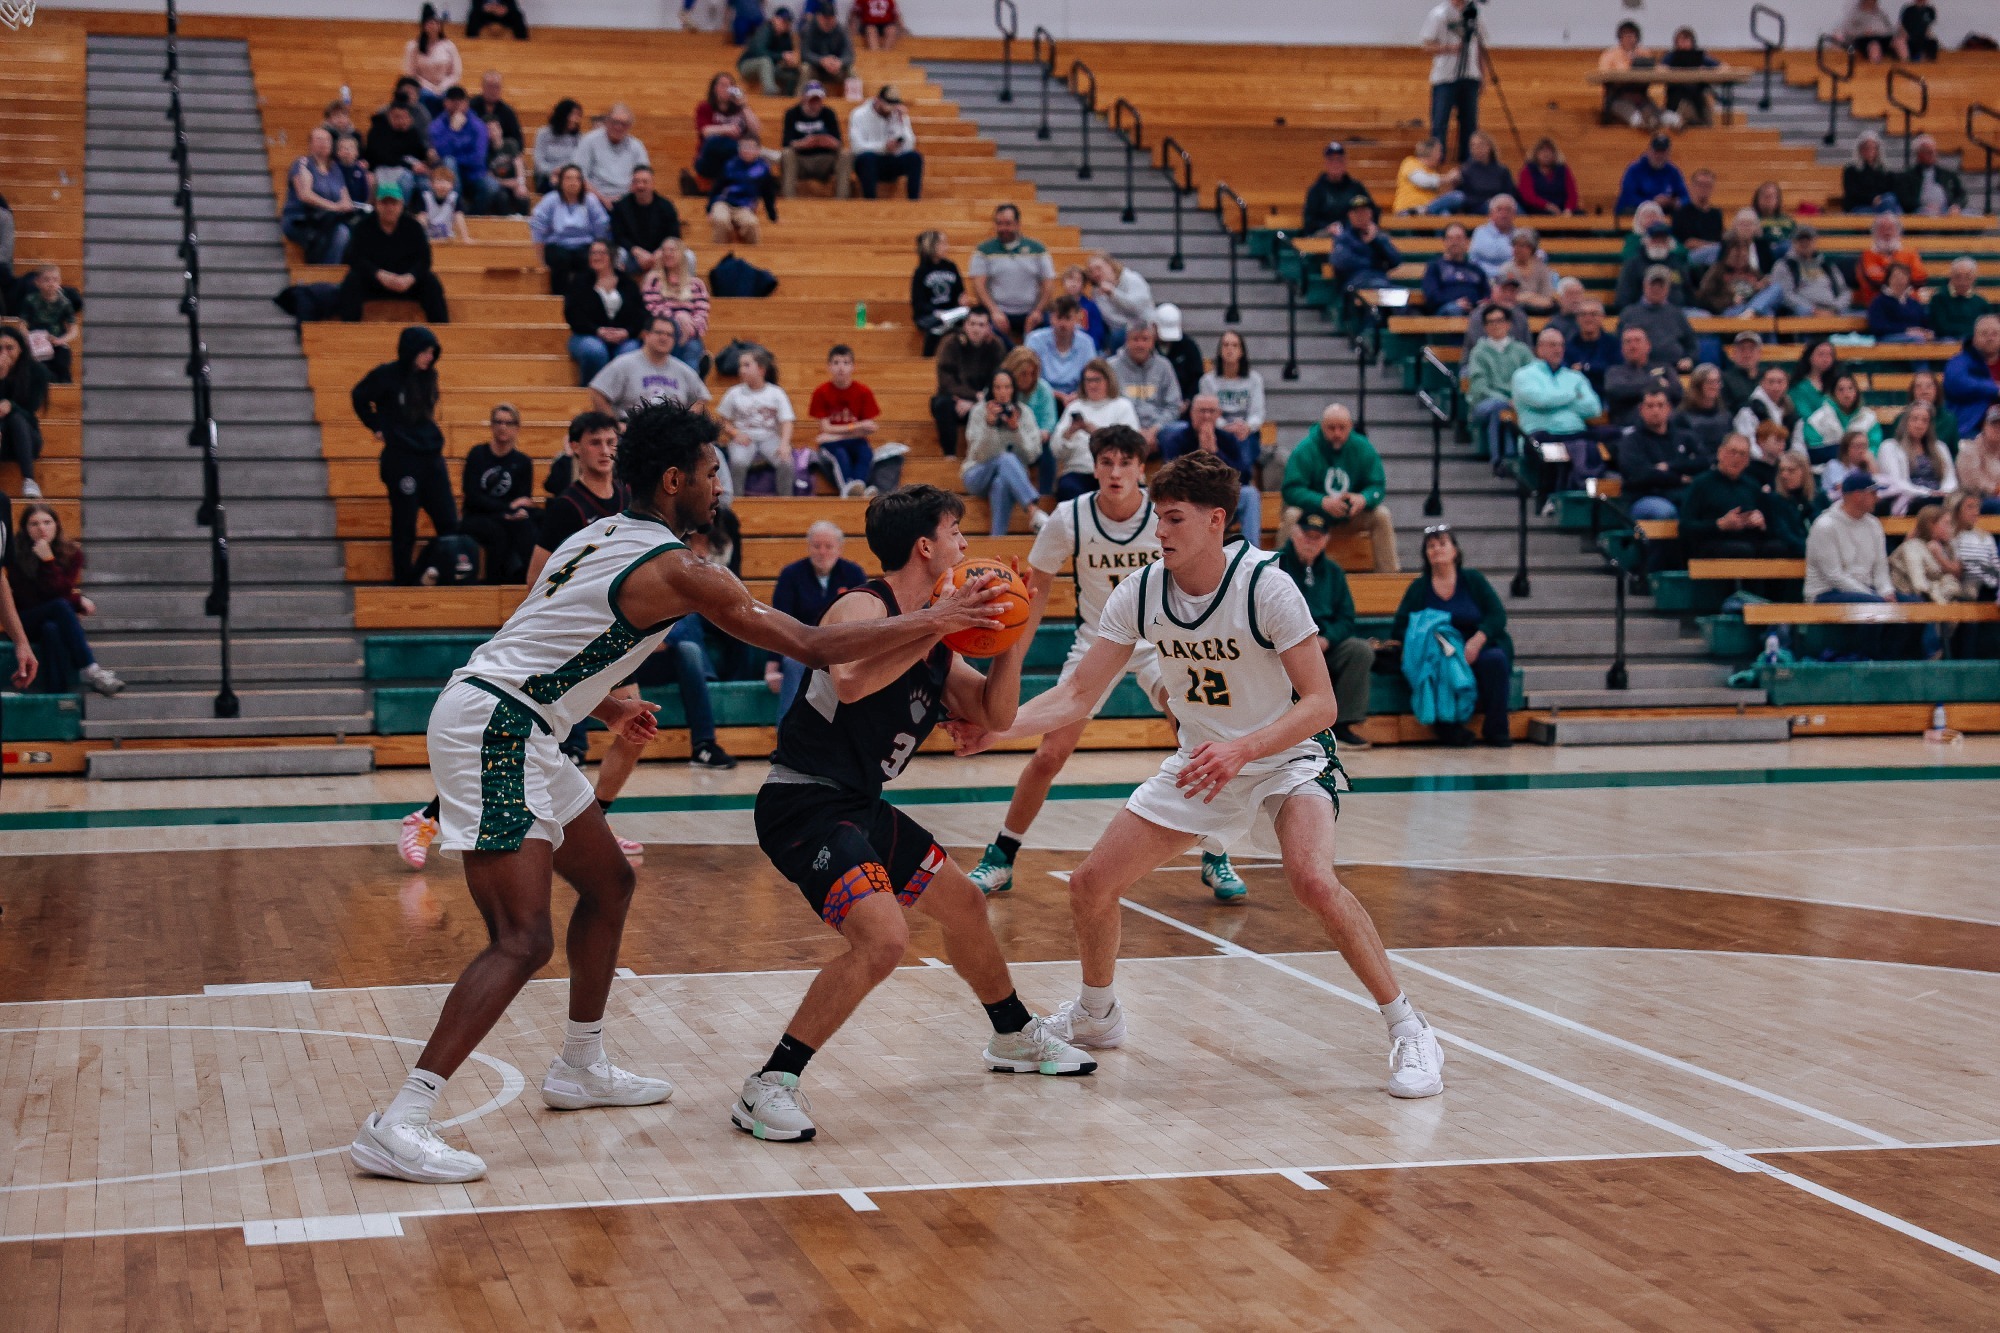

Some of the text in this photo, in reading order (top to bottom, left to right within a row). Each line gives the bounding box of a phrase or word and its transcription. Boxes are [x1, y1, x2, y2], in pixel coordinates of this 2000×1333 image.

[544, 543, 600, 599] 4
[1155, 637, 1241, 662] LAKERS
[1184, 665, 1233, 709] 12
[880, 732, 917, 780] 3
